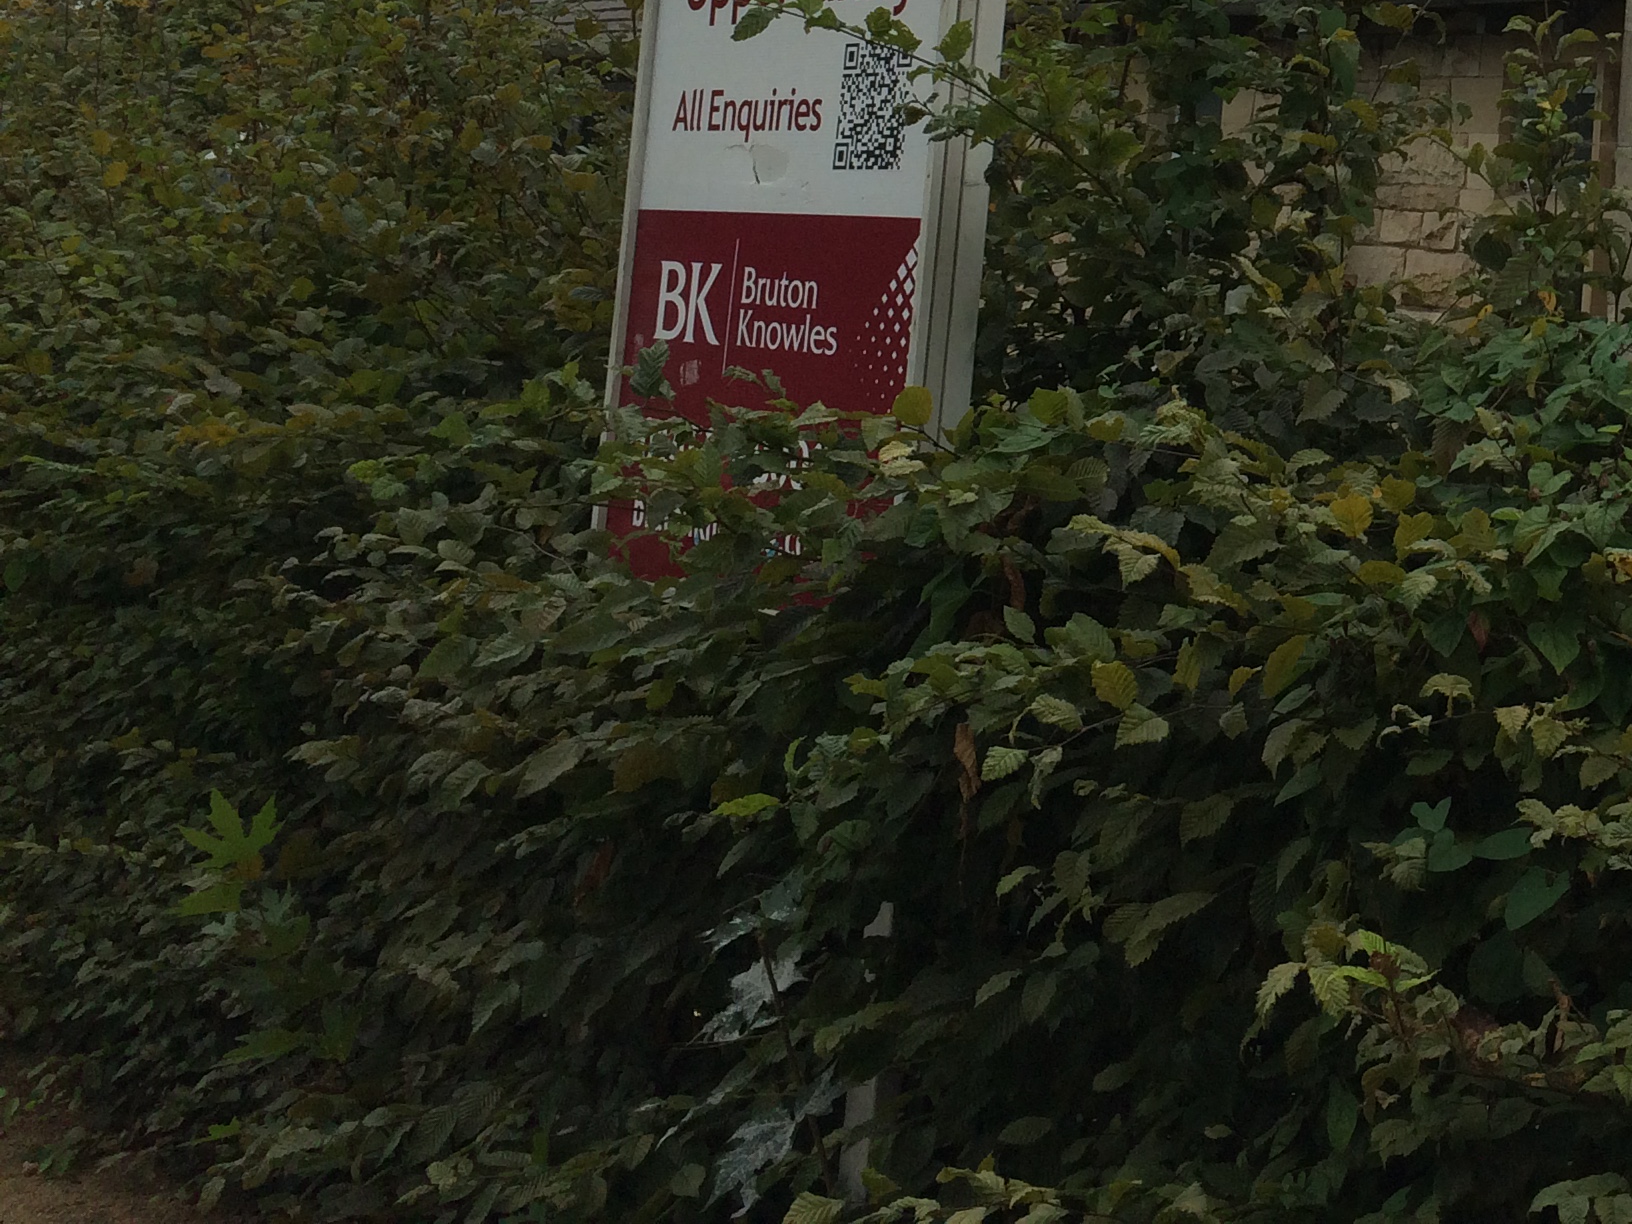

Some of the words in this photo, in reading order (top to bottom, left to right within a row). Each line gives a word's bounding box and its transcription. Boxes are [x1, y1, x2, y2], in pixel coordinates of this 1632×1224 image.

[672, 88, 705, 132] All
[707, 88, 823, 142] Enquiries
[653, 260, 723, 347] BK
[740, 266, 818, 310] Bruton
[736, 309, 838, 356] Knowles
